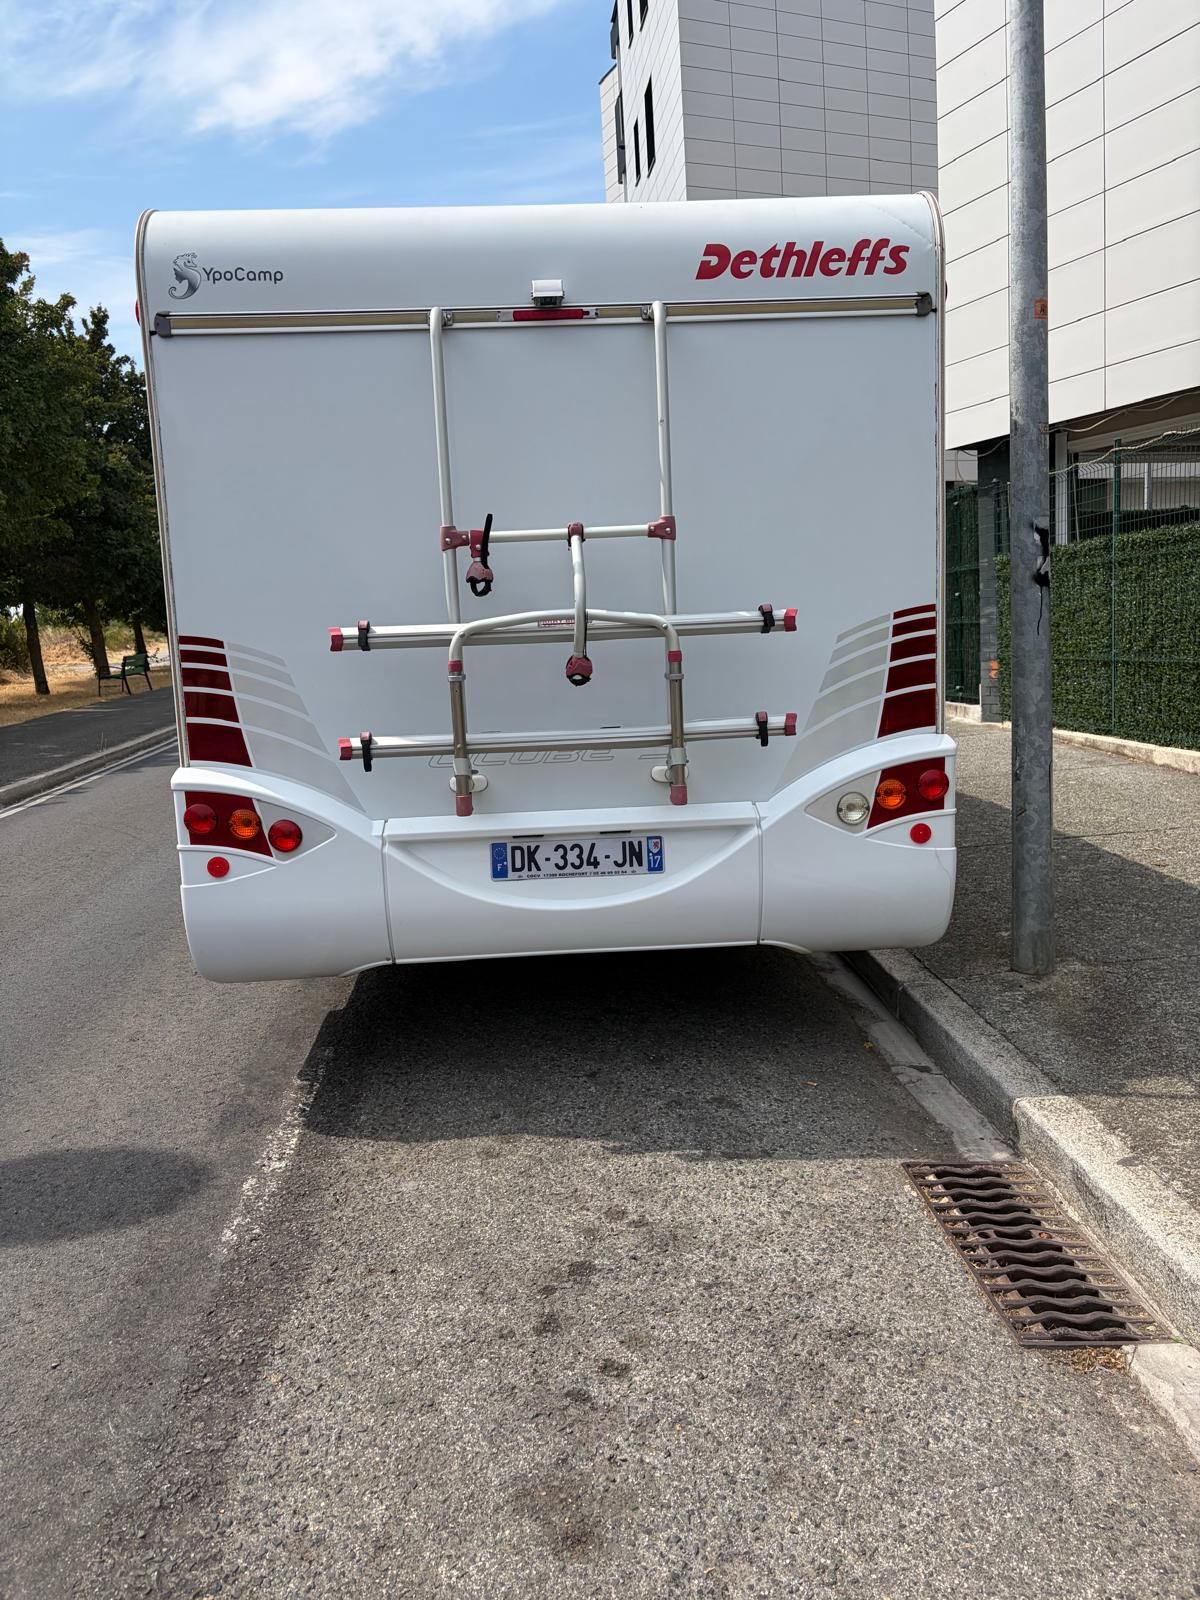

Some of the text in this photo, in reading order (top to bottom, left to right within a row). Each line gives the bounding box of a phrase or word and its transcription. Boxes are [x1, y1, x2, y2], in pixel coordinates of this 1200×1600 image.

[695, 238, 910, 280] Dethleffs
[202, 267, 284, 284] YpoCamp
[510, 840, 643, 873] DK-334-JN
[649, 855, 661, 868] 17
[497, 863, 503, 872] F
